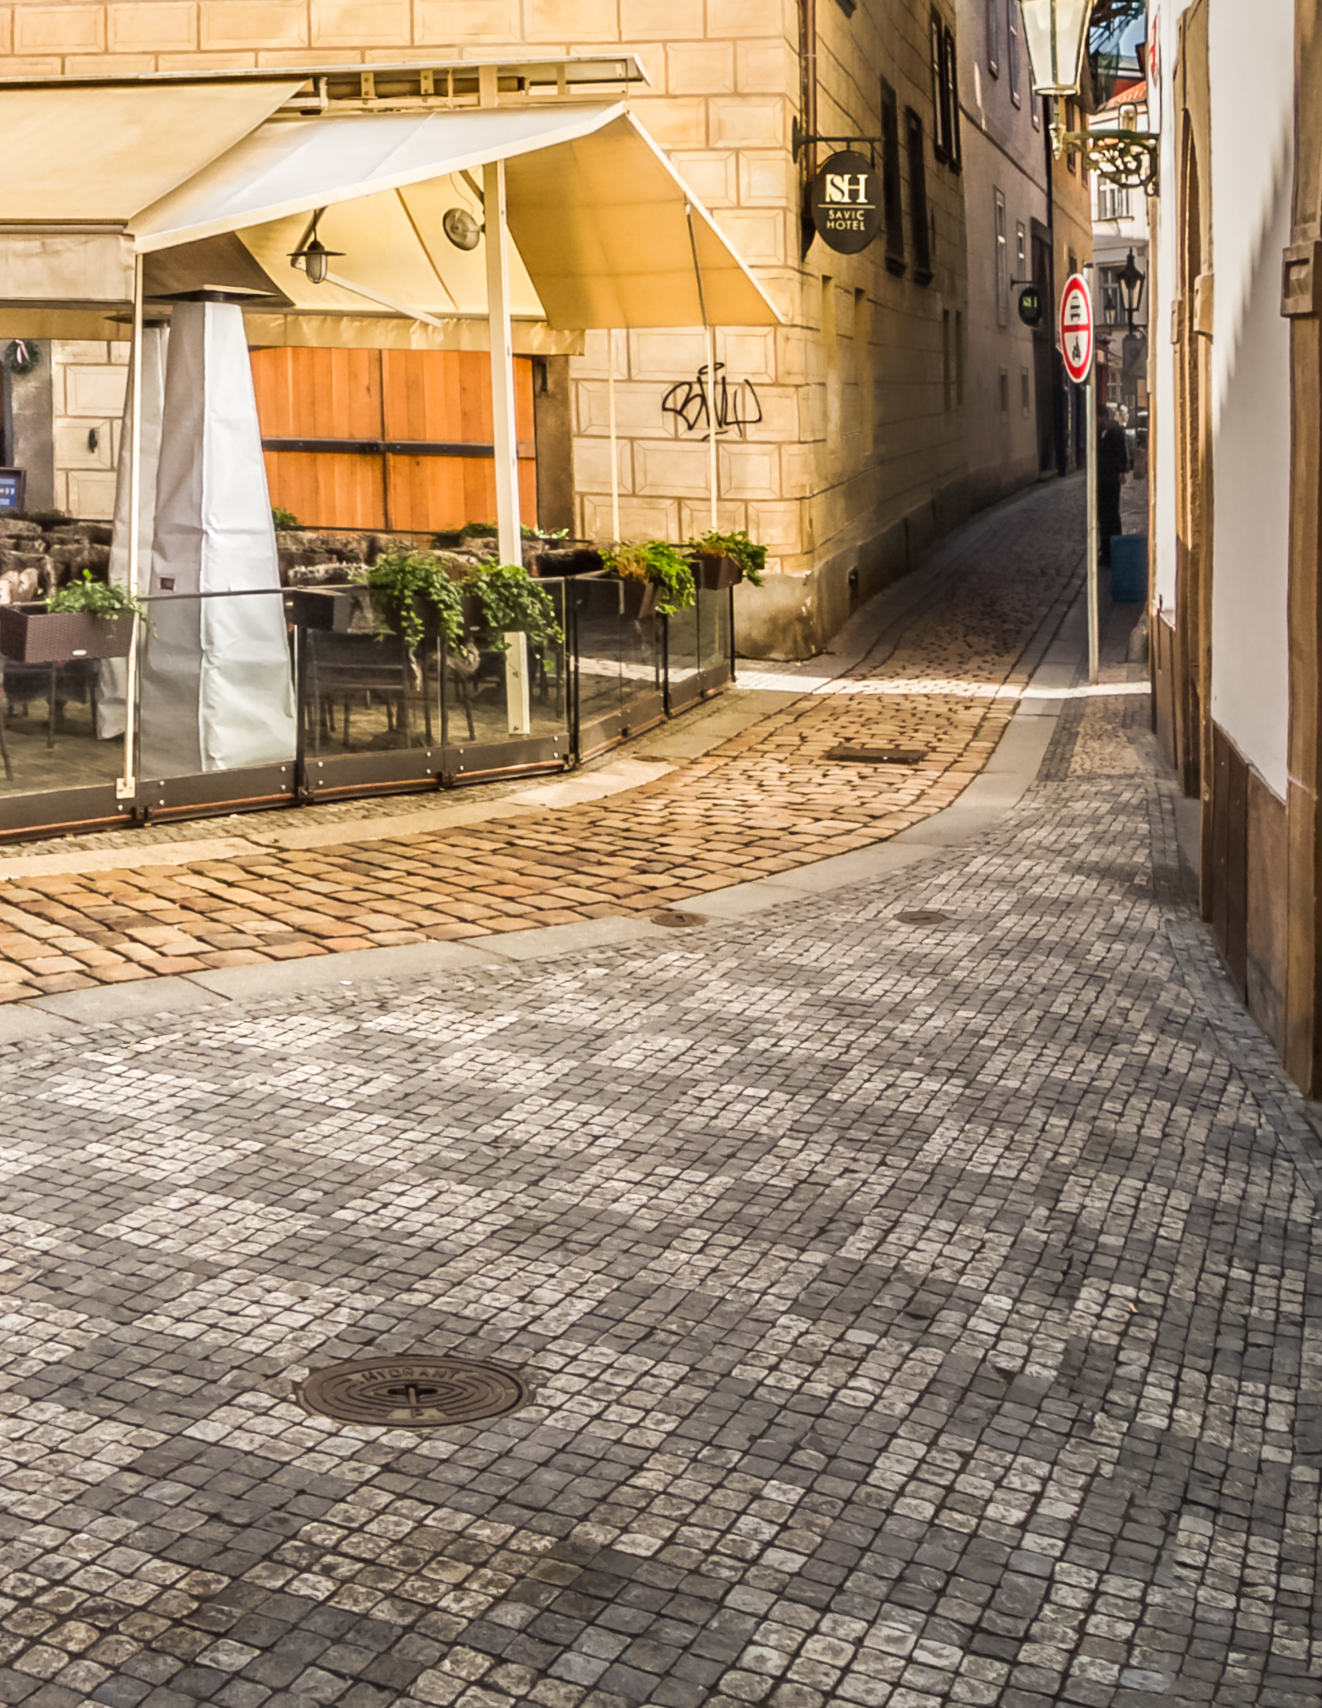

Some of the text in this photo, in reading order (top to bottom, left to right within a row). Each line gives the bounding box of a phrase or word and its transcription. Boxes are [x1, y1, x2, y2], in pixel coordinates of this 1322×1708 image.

[829, 209, 864, 220] SAVIC
[826, 220, 865, 231] HOTEL
[359, 1367, 461, 1385] HYDRANT
